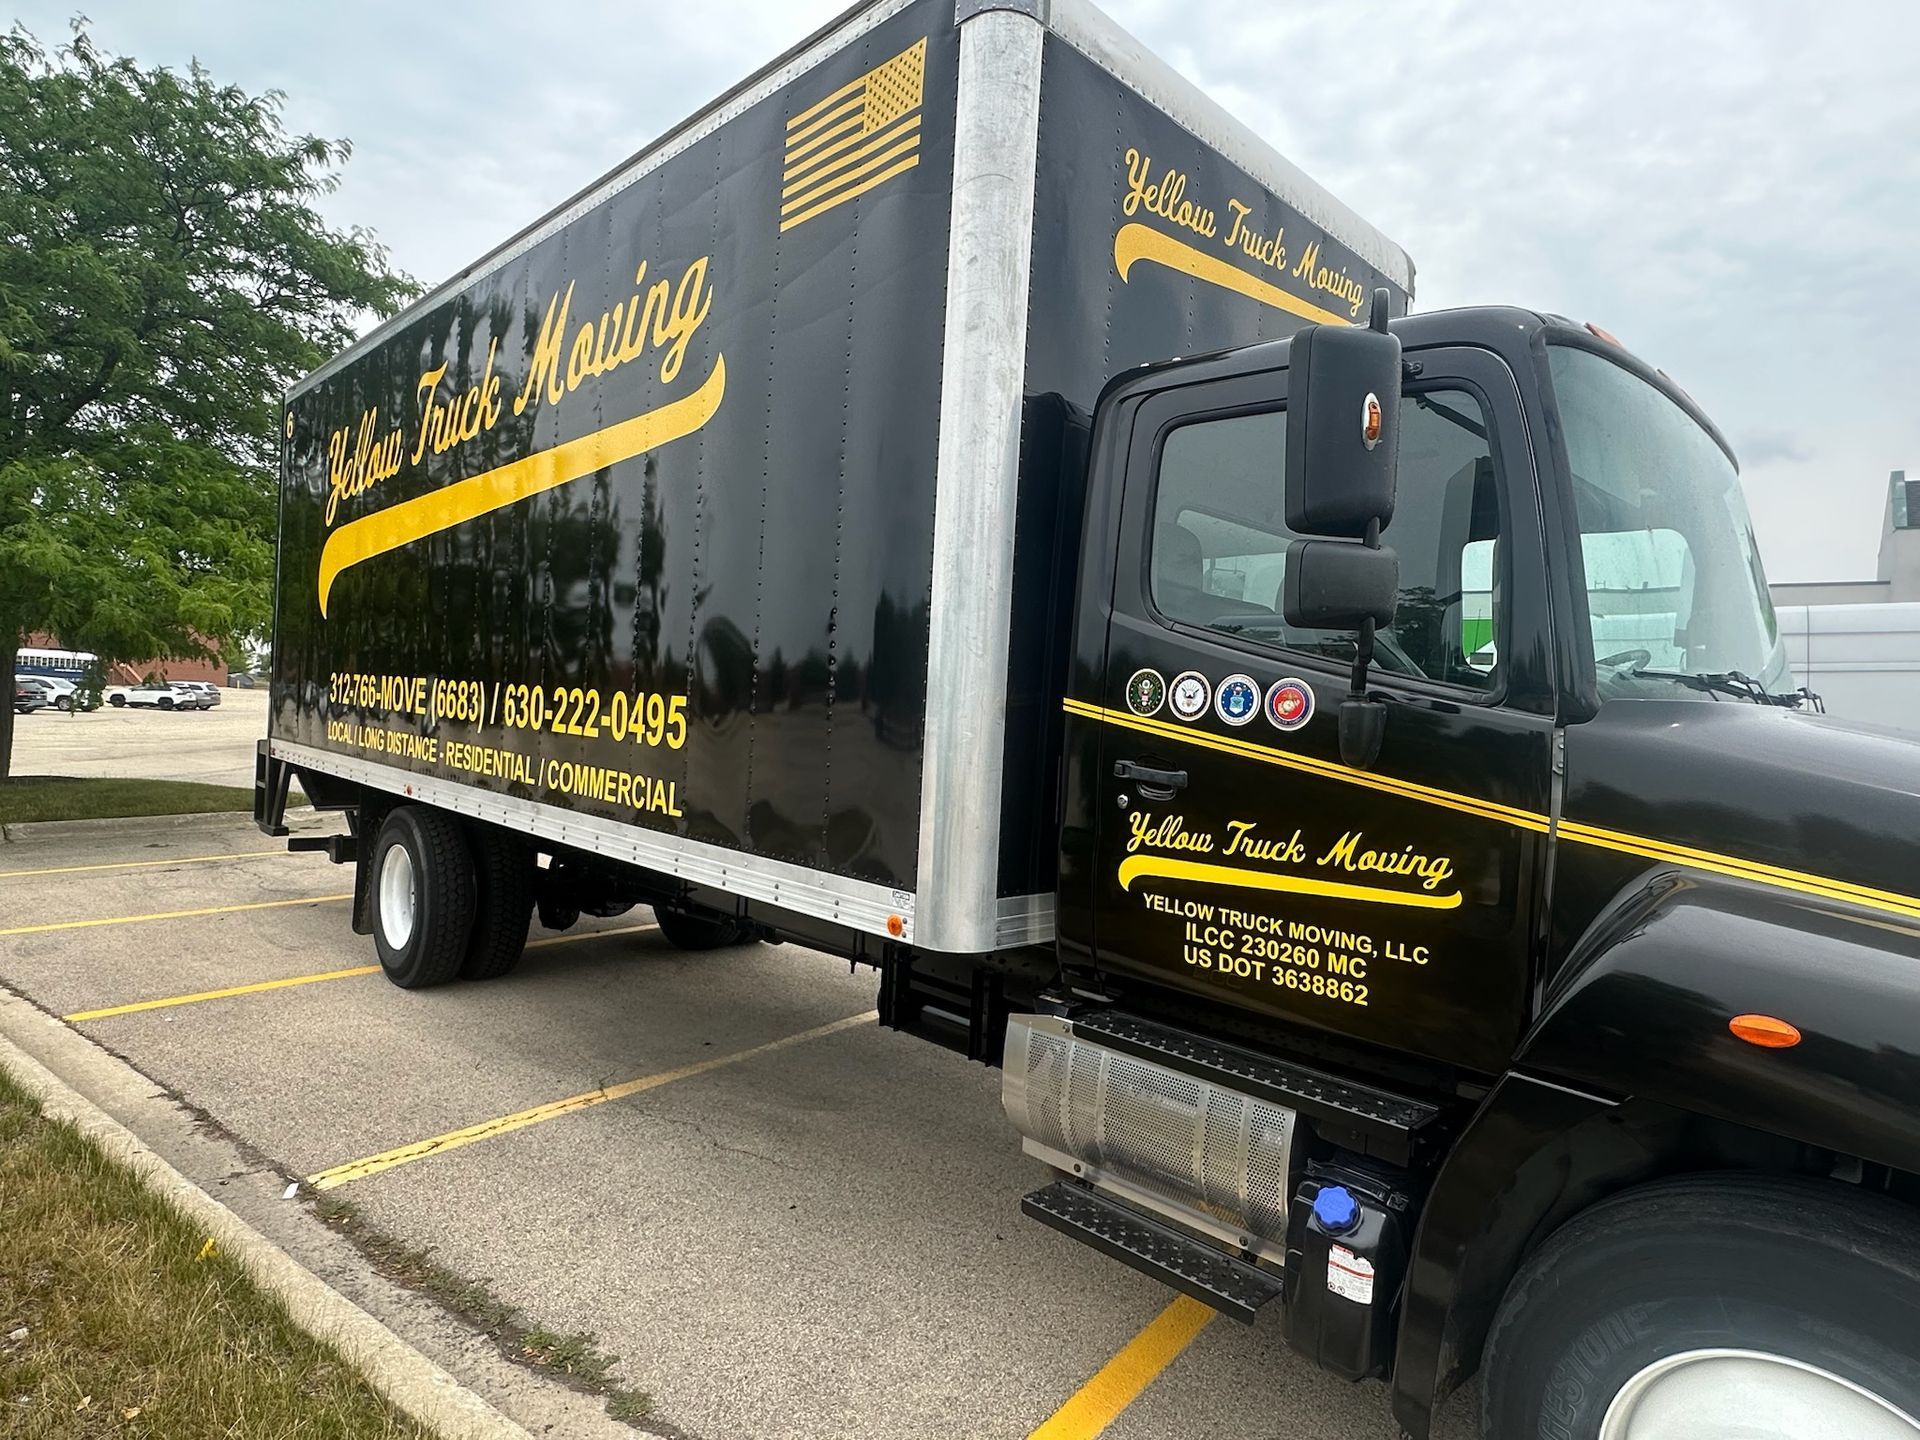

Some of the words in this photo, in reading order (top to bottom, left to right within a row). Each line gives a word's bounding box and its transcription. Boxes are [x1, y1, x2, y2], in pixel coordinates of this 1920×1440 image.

[1122, 148, 1217, 238] Yellow
[1224, 198, 1287, 271] Truck
[1292, 240, 1364, 318] Moving
[286, 411, 294, 439] 6
[325, 406, 403, 527] Yellow
[411, 336, 502, 466] Truck
[514, 255, 713, 417] Moving
[329, 672, 427, 715] 312-766-MOVE
[431, 677, 485, 734] (6683)
[490, 682, 500, 725] /
[504, 684, 688, 750] 630-222-0495
[327, 720, 352, 745] LOCAL
[358, 725, 385, 752] LONG
[386, 730, 438, 763] DISTANCE
[446, 742, 536, 785] RESIDENTIAL
[547, 760, 684, 818] COMMERCIAL
[1126, 811, 1214, 853] Yellow
[1222, 820, 1306, 863] Truck
[1316, 831, 1454, 890] Moving
[1143, 893, 1214, 922] YELLOW
[1218, 907, 1283, 936] TRUCK
[1289, 922, 1379, 959] MOVING,
[1385, 940, 1430, 966] LLC
[1185, 922, 1235, 950] ILCC
[1240, 934, 1320, 970] 230260
[1327, 951, 1368, 980] MC
[1184, 945, 1212, 969] US
[1218, 952, 1266, 982] DOT
[1272, 965, 1369, 1007] 3638862
